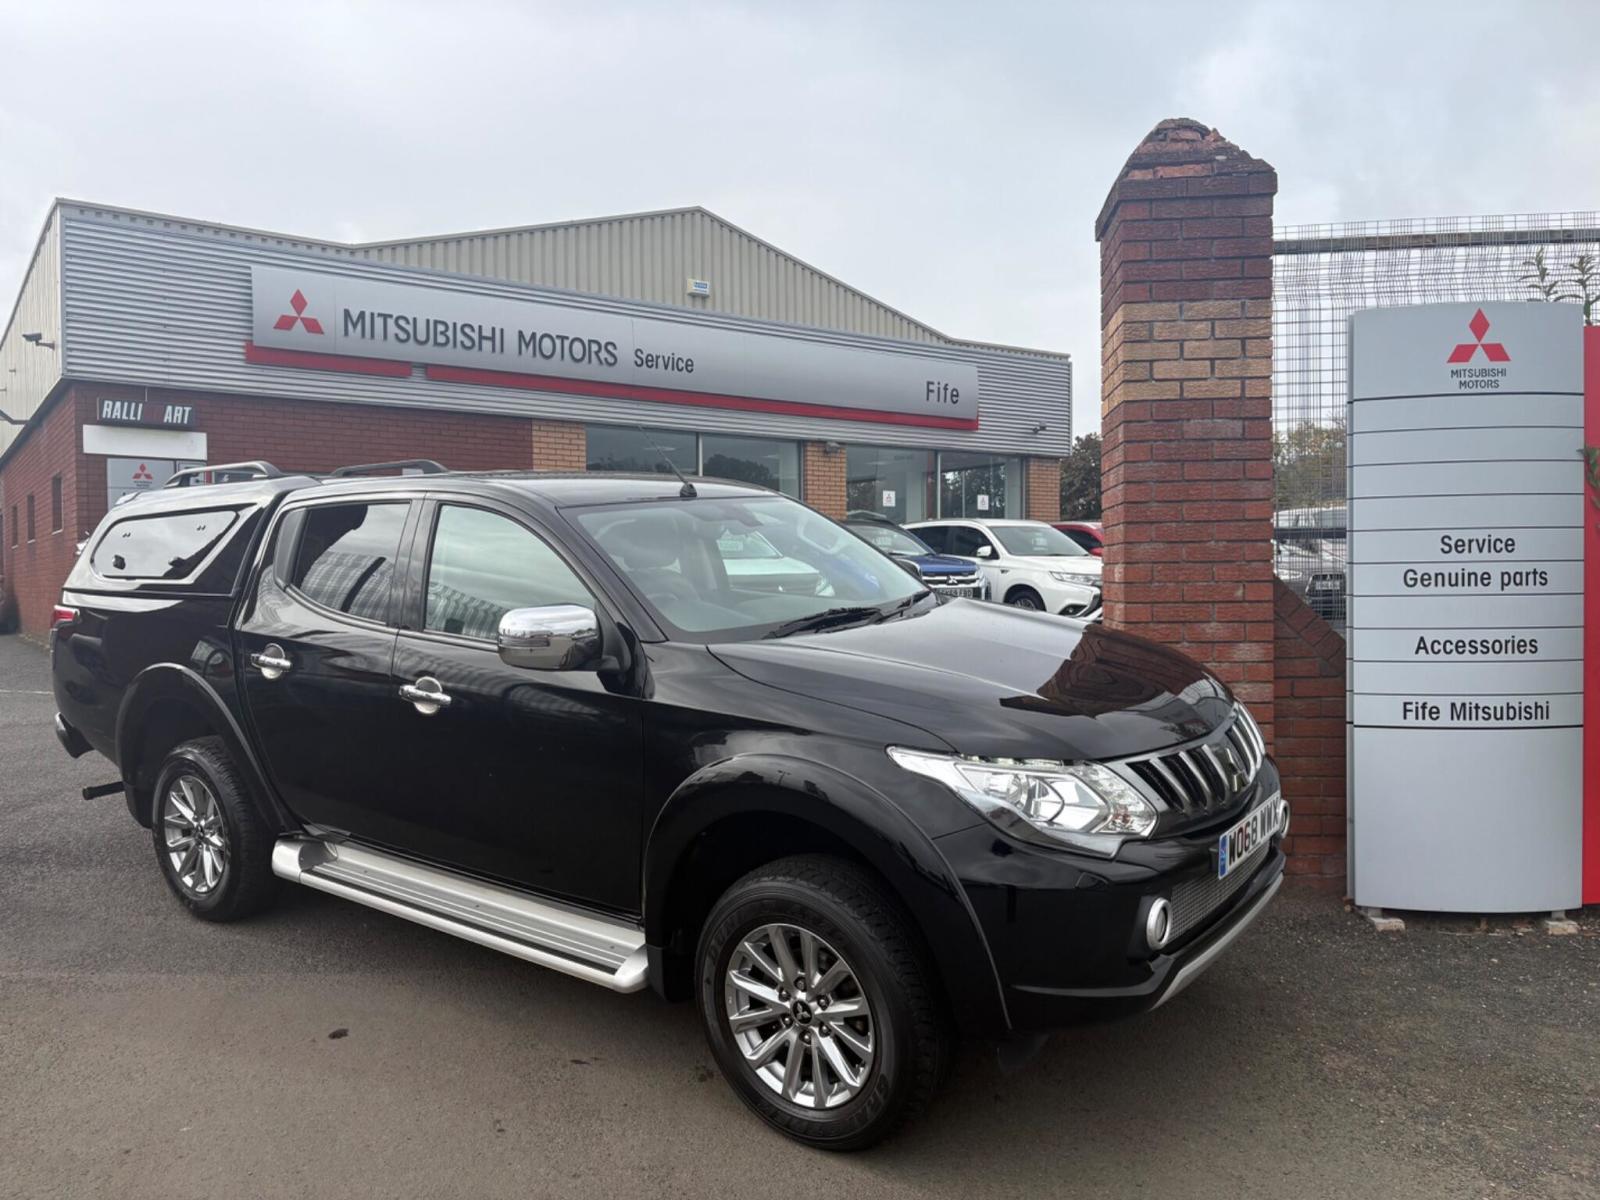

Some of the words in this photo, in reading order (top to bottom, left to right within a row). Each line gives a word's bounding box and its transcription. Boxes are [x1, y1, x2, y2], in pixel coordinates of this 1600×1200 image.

[343, 308, 504, 353] MITSUBISHI
[517, 329, 617, 367] MOTORS
[633, 348, 694, 373] Service
[1450, 368, 1507, 378] MITSUBISHI
[926, 380, 959, 404] Fife
[1459, 379, 1500, 389] MOTORS
[102, 400, 143, 421] RALLI
[163, 405, 192, 424] ART
[1440, 534, 1516, 554] Service
[1403, 568, 1492, 588] Genuine
[1501, 568, 1549, 591] parts
[1414, 635, 1539, 655] Accessories
[1402, 701, 1441, 721] Fife
[1450, 700, 1550, 721] Mitsubishi
